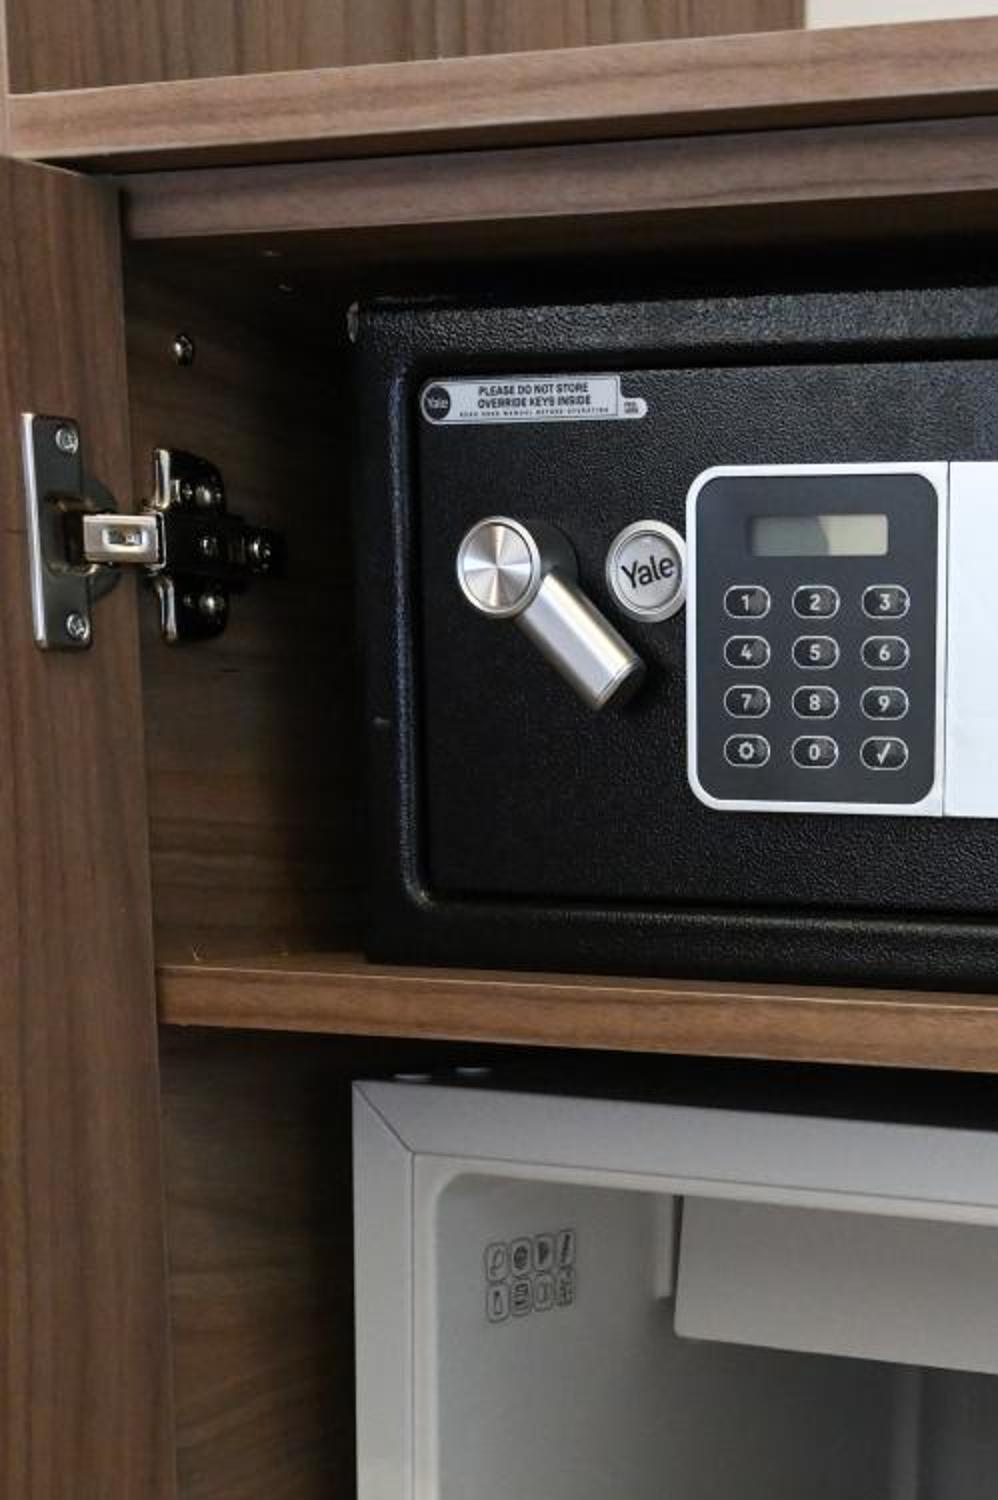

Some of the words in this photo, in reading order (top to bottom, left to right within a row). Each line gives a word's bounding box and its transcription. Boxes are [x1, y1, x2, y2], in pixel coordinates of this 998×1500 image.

[478, 384, 515, 396] PLEASE
[517, 384, 533, 395] DO
[534, 383, 555, 394] NOT
[556, 382, 589, 393] STORE
[478, 397, 527, 409] OVERRIDE
[529, 395, 555, 407] KEYS
[558, 394, 592, 406] INSIDE
[621, 555, 674, 589] Yale
[741, 595, 750, 612] 1
[809, 594, 821, 612] 2
[879, 593, 891, 611] 3
[741, 643, 752, 661] 4
[809, 644, 821, 661] 5
[879, 643, 891, 661] 6
[741, 693, 752, 710] 7
[809, 694, 821, 711] 8
[879, 695, 890, 712] 9
[809, 744, 821, 761] 0
